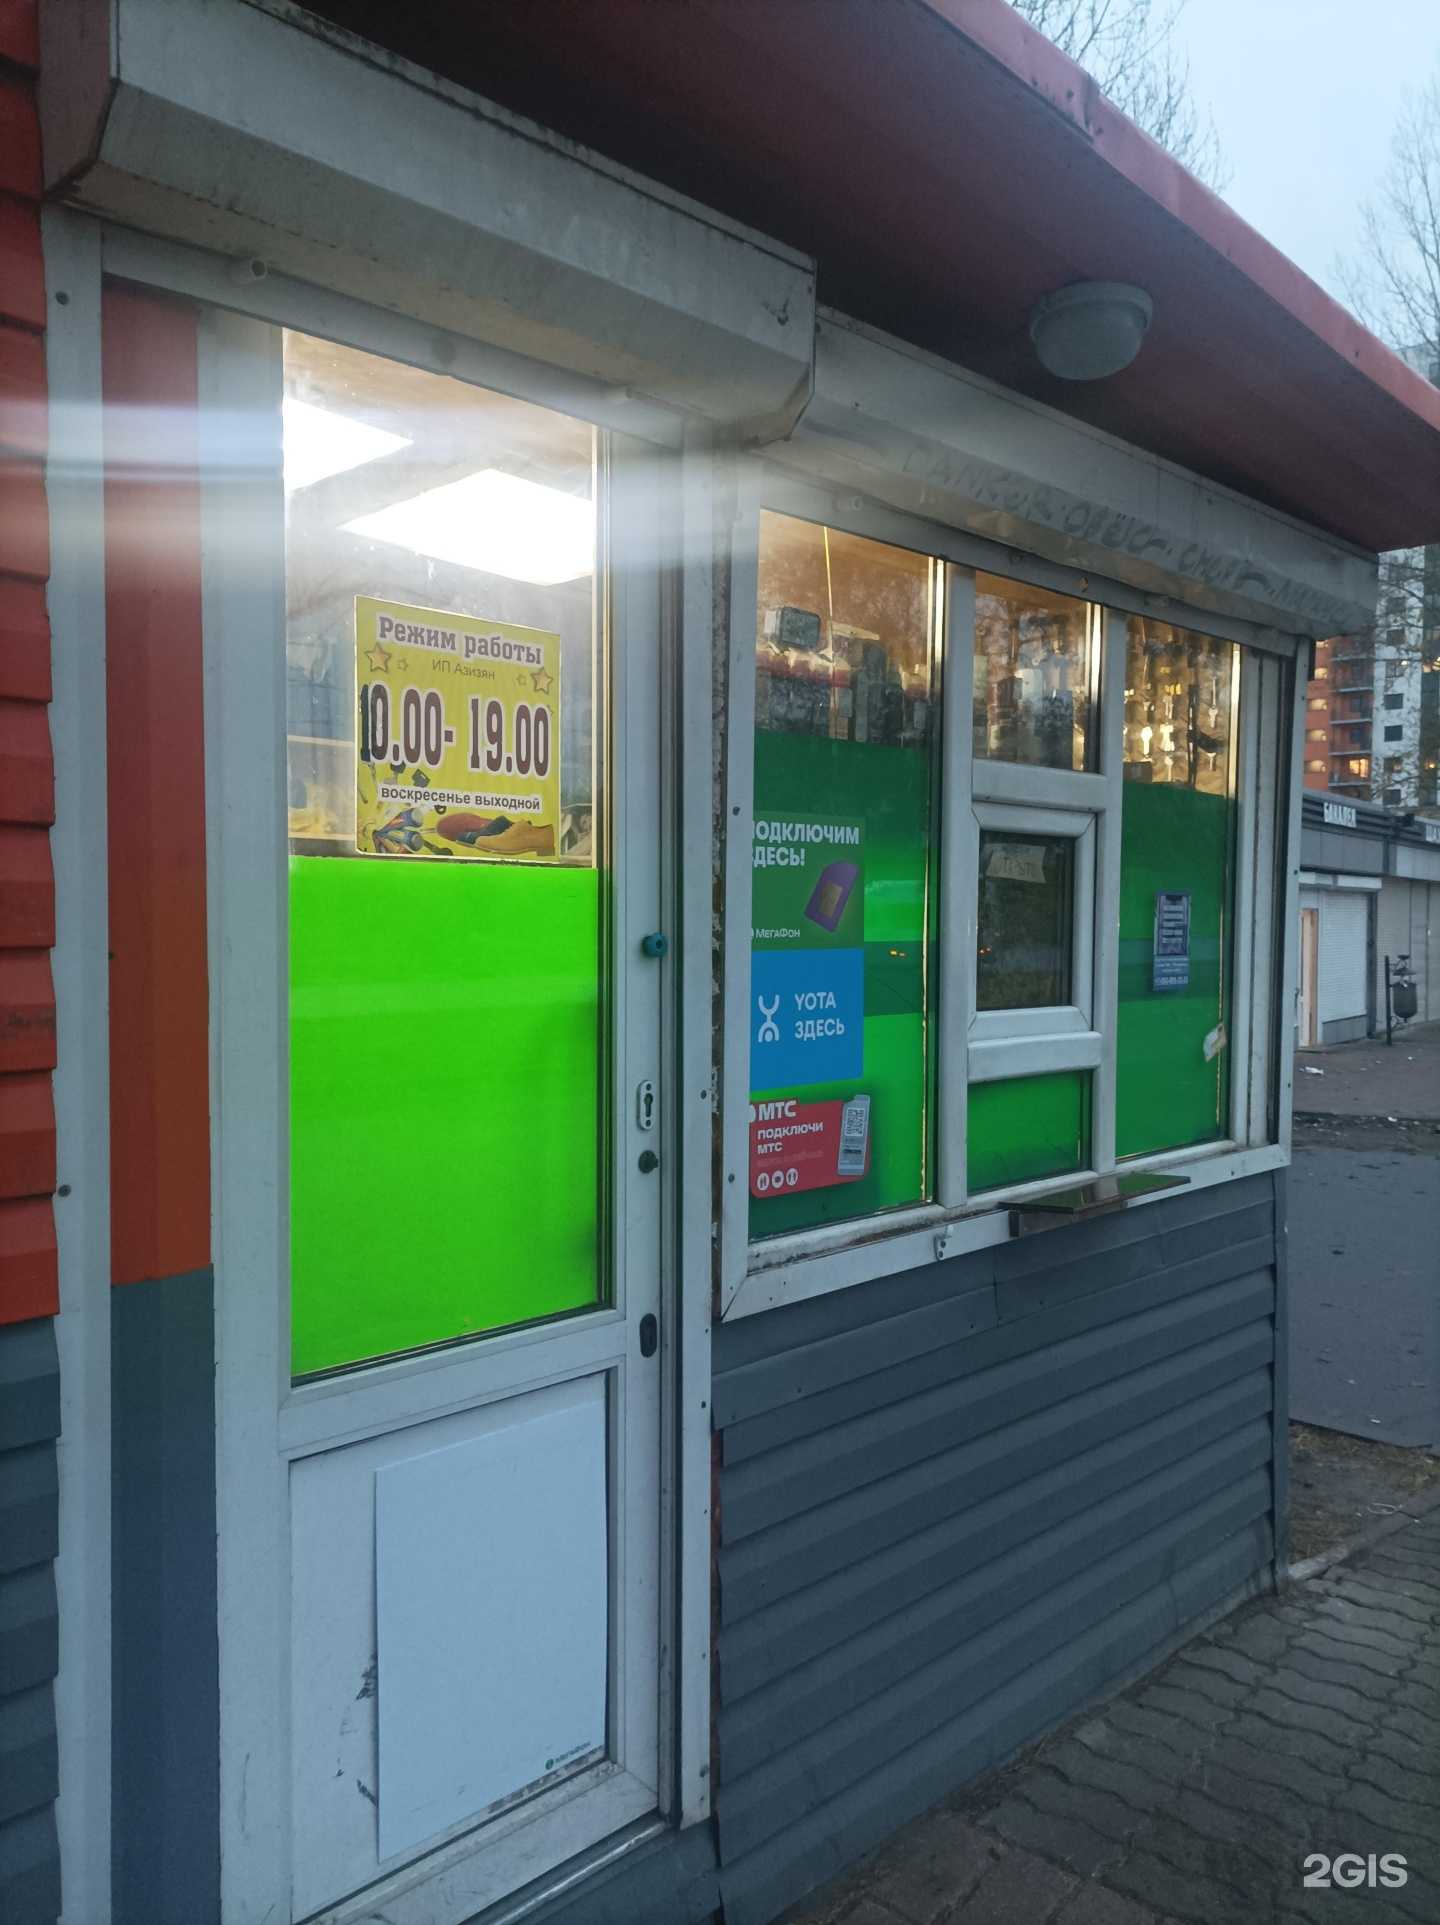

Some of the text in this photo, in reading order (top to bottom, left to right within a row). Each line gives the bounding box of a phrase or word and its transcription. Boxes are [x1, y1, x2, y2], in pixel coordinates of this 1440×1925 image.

[379, 617, 541, 664] Режим работы
[432, 659, 495, 681] ИП Азизян
[470, 698, 548, 776] 19.00
[381, 787, 540, 810] воскресенье выходной
[753, 821, 859, 845] ОДКЛЮЧИМ
[753, 846, 805, 868] ДЕСЬ!
[794, 992, 837, 1011] YOTA
[794, 1018, 845, 1041] ЗДЕСЬ
[758, 1100, 797, 1121] МТС
